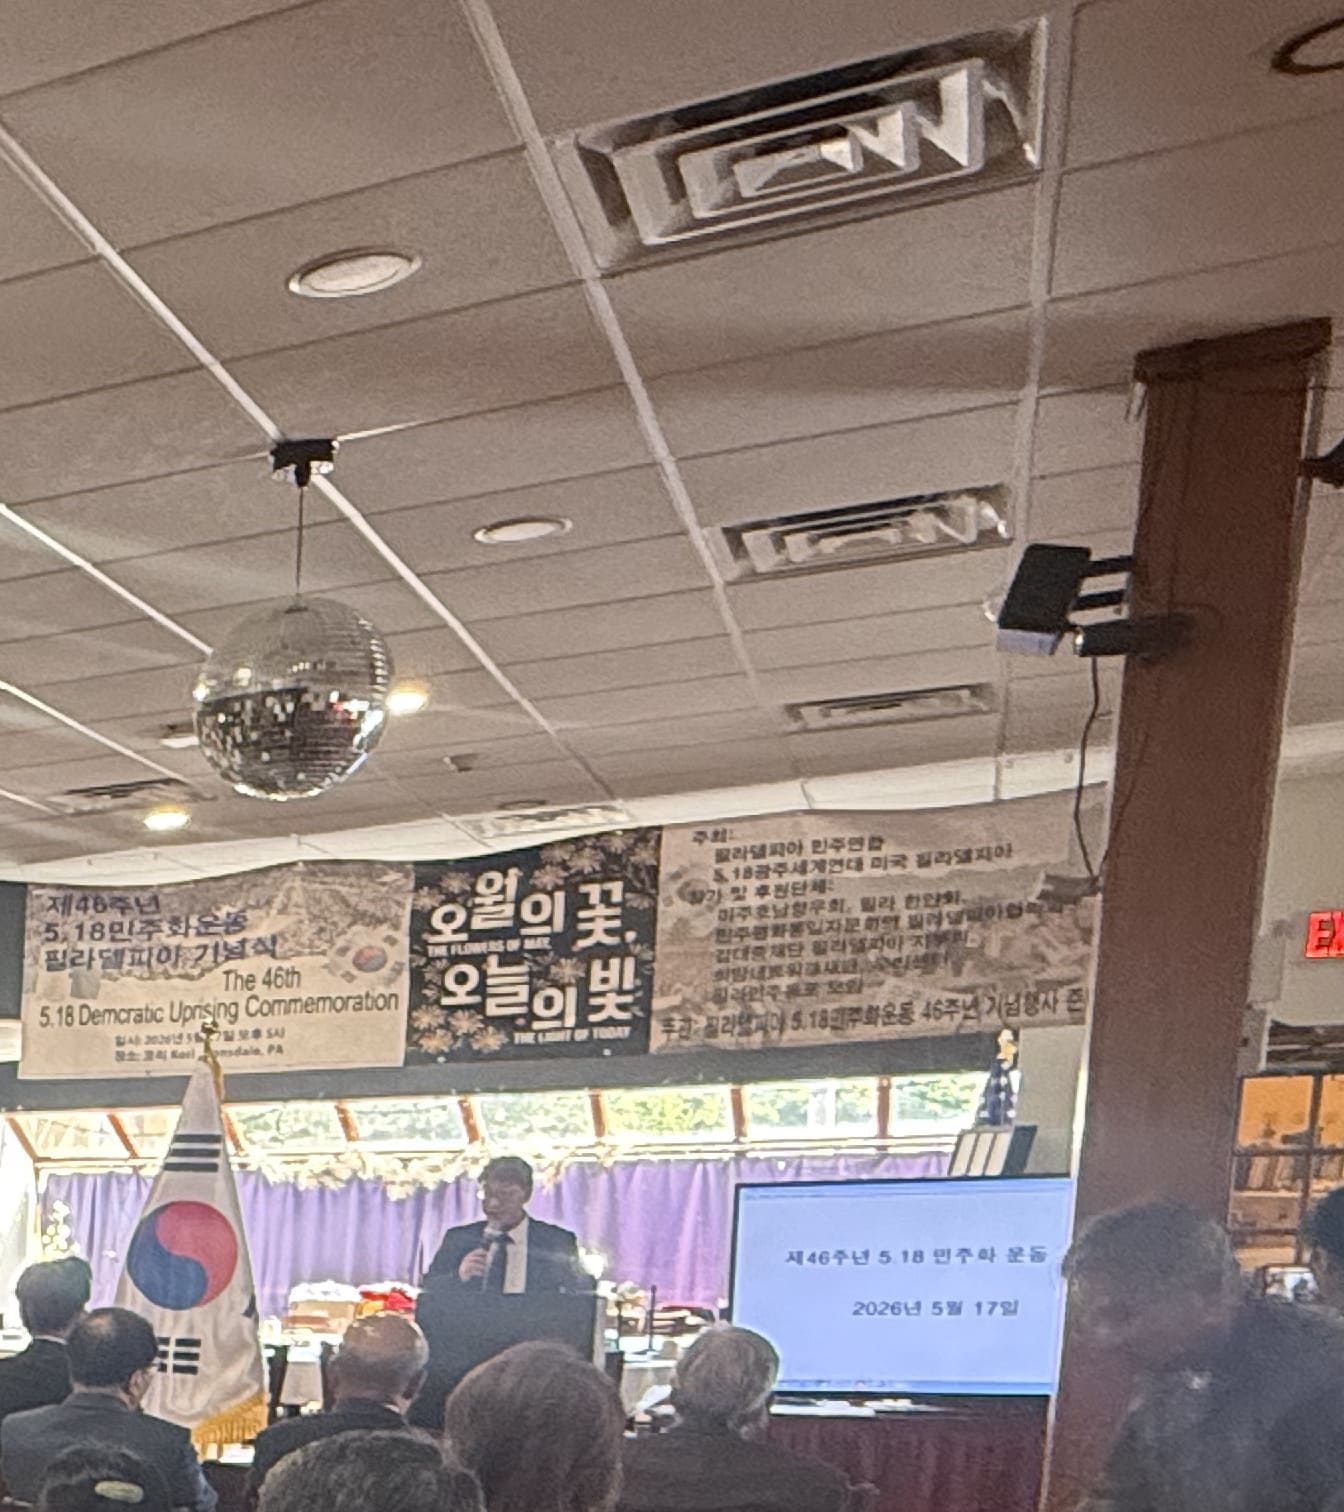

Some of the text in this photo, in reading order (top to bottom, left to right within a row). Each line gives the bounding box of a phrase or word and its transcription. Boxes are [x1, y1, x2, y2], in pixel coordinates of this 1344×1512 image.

[46, 893, 160, 916] 제46주년
[426, 867, 566, 944] 오월의
[43, 910, 248, 943] 5.18민주화운동
[45, 933, 278, 972] 필라델피아 기념식
[223, 966, 301, 992] The 46th
[440, 953, 636, 1031] 오늘의 빛
[39, 1004, 74, 1028] 5.18
[169, 998, 239, 1025] Uprising
[244, 991, 400, 1018] Commemoration
[784, 1249, 870, 1266] 제46주년
[932, 1247, 997, 1266] 민주화
[1005, 1246, 1048, 1265] 운동
[851, 1299, 1019, 1317] 2026년 5월 17일
